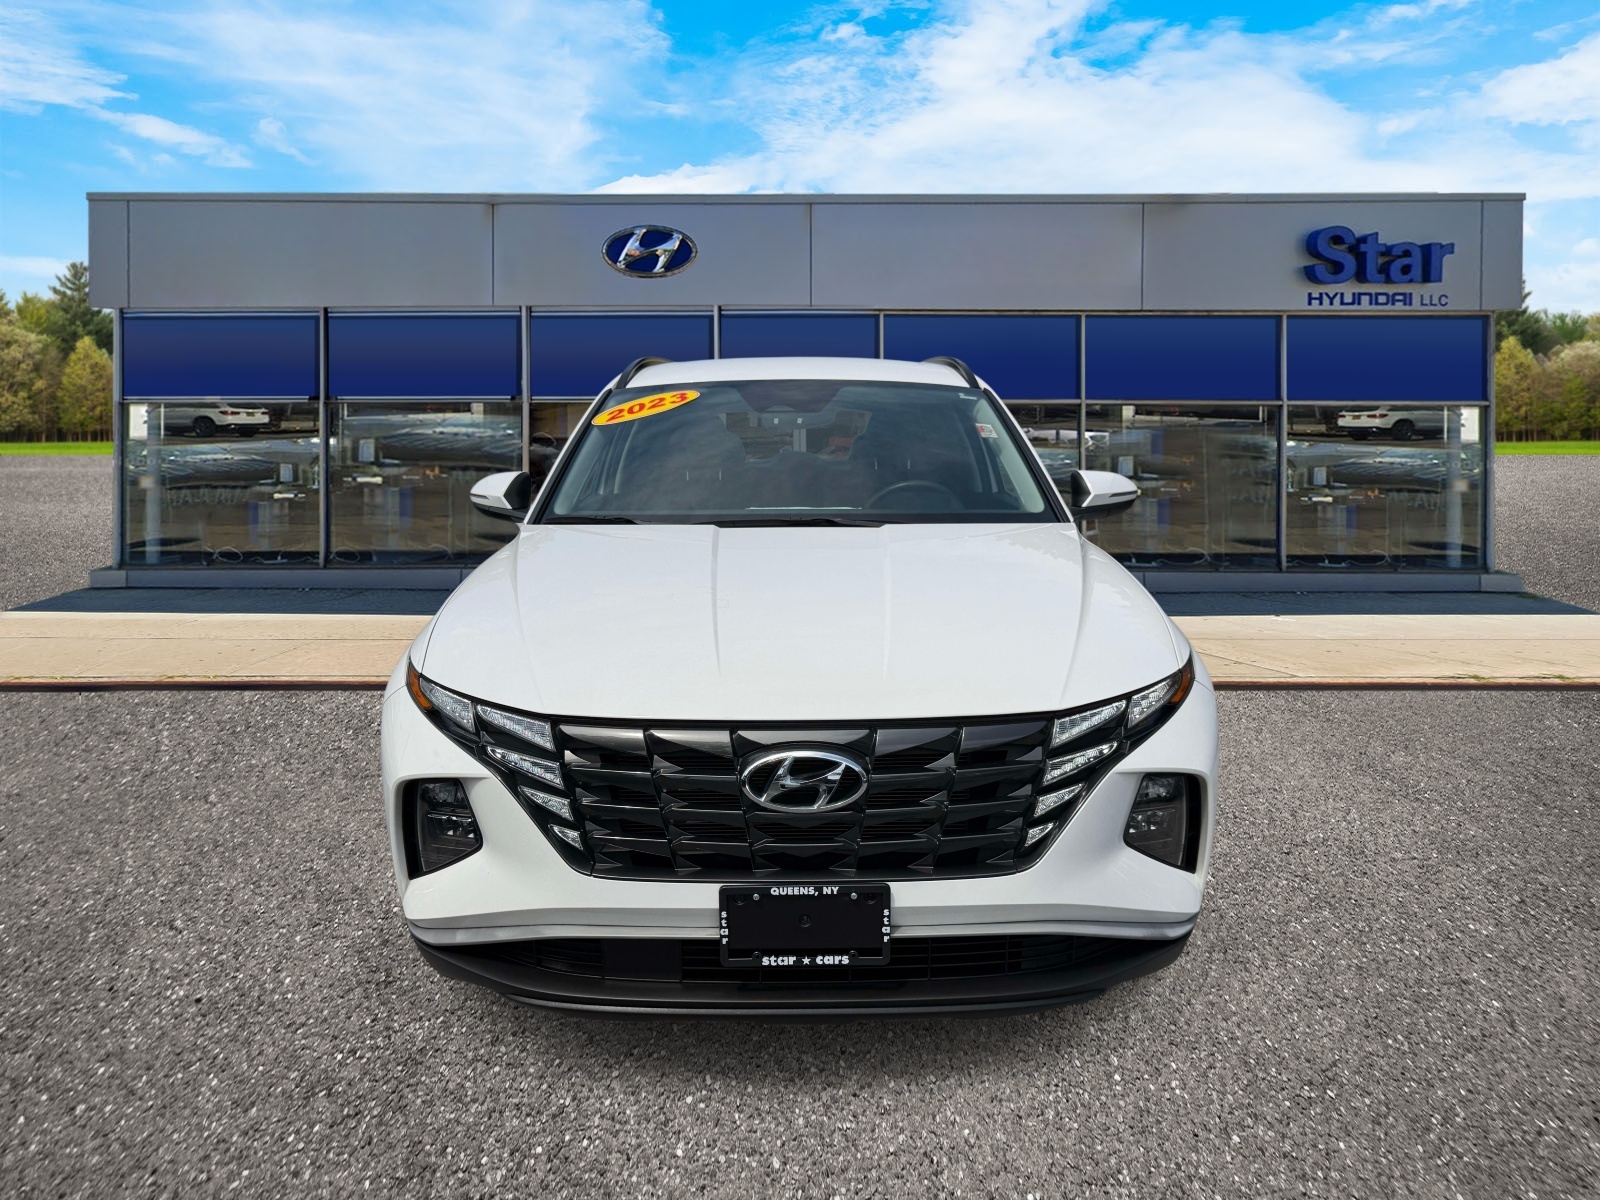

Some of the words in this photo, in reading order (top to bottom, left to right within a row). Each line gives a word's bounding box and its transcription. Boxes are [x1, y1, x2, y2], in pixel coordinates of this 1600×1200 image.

[1303, 225, 1454, 285] Star
[1307, 292, 1413, 306] HYUNDAI
[1420, 294, 1449, 307] LLC
[606, 392, 689, 423] 2023
[770, 886, 818, 896] QUEENS,
[822, 886, 839, 895] NY
[720, 910, 729, 945] star
[881, 908, 891, 943] star
[761, 955, 797, 966] star
[815, 954, 850, 965] cars
